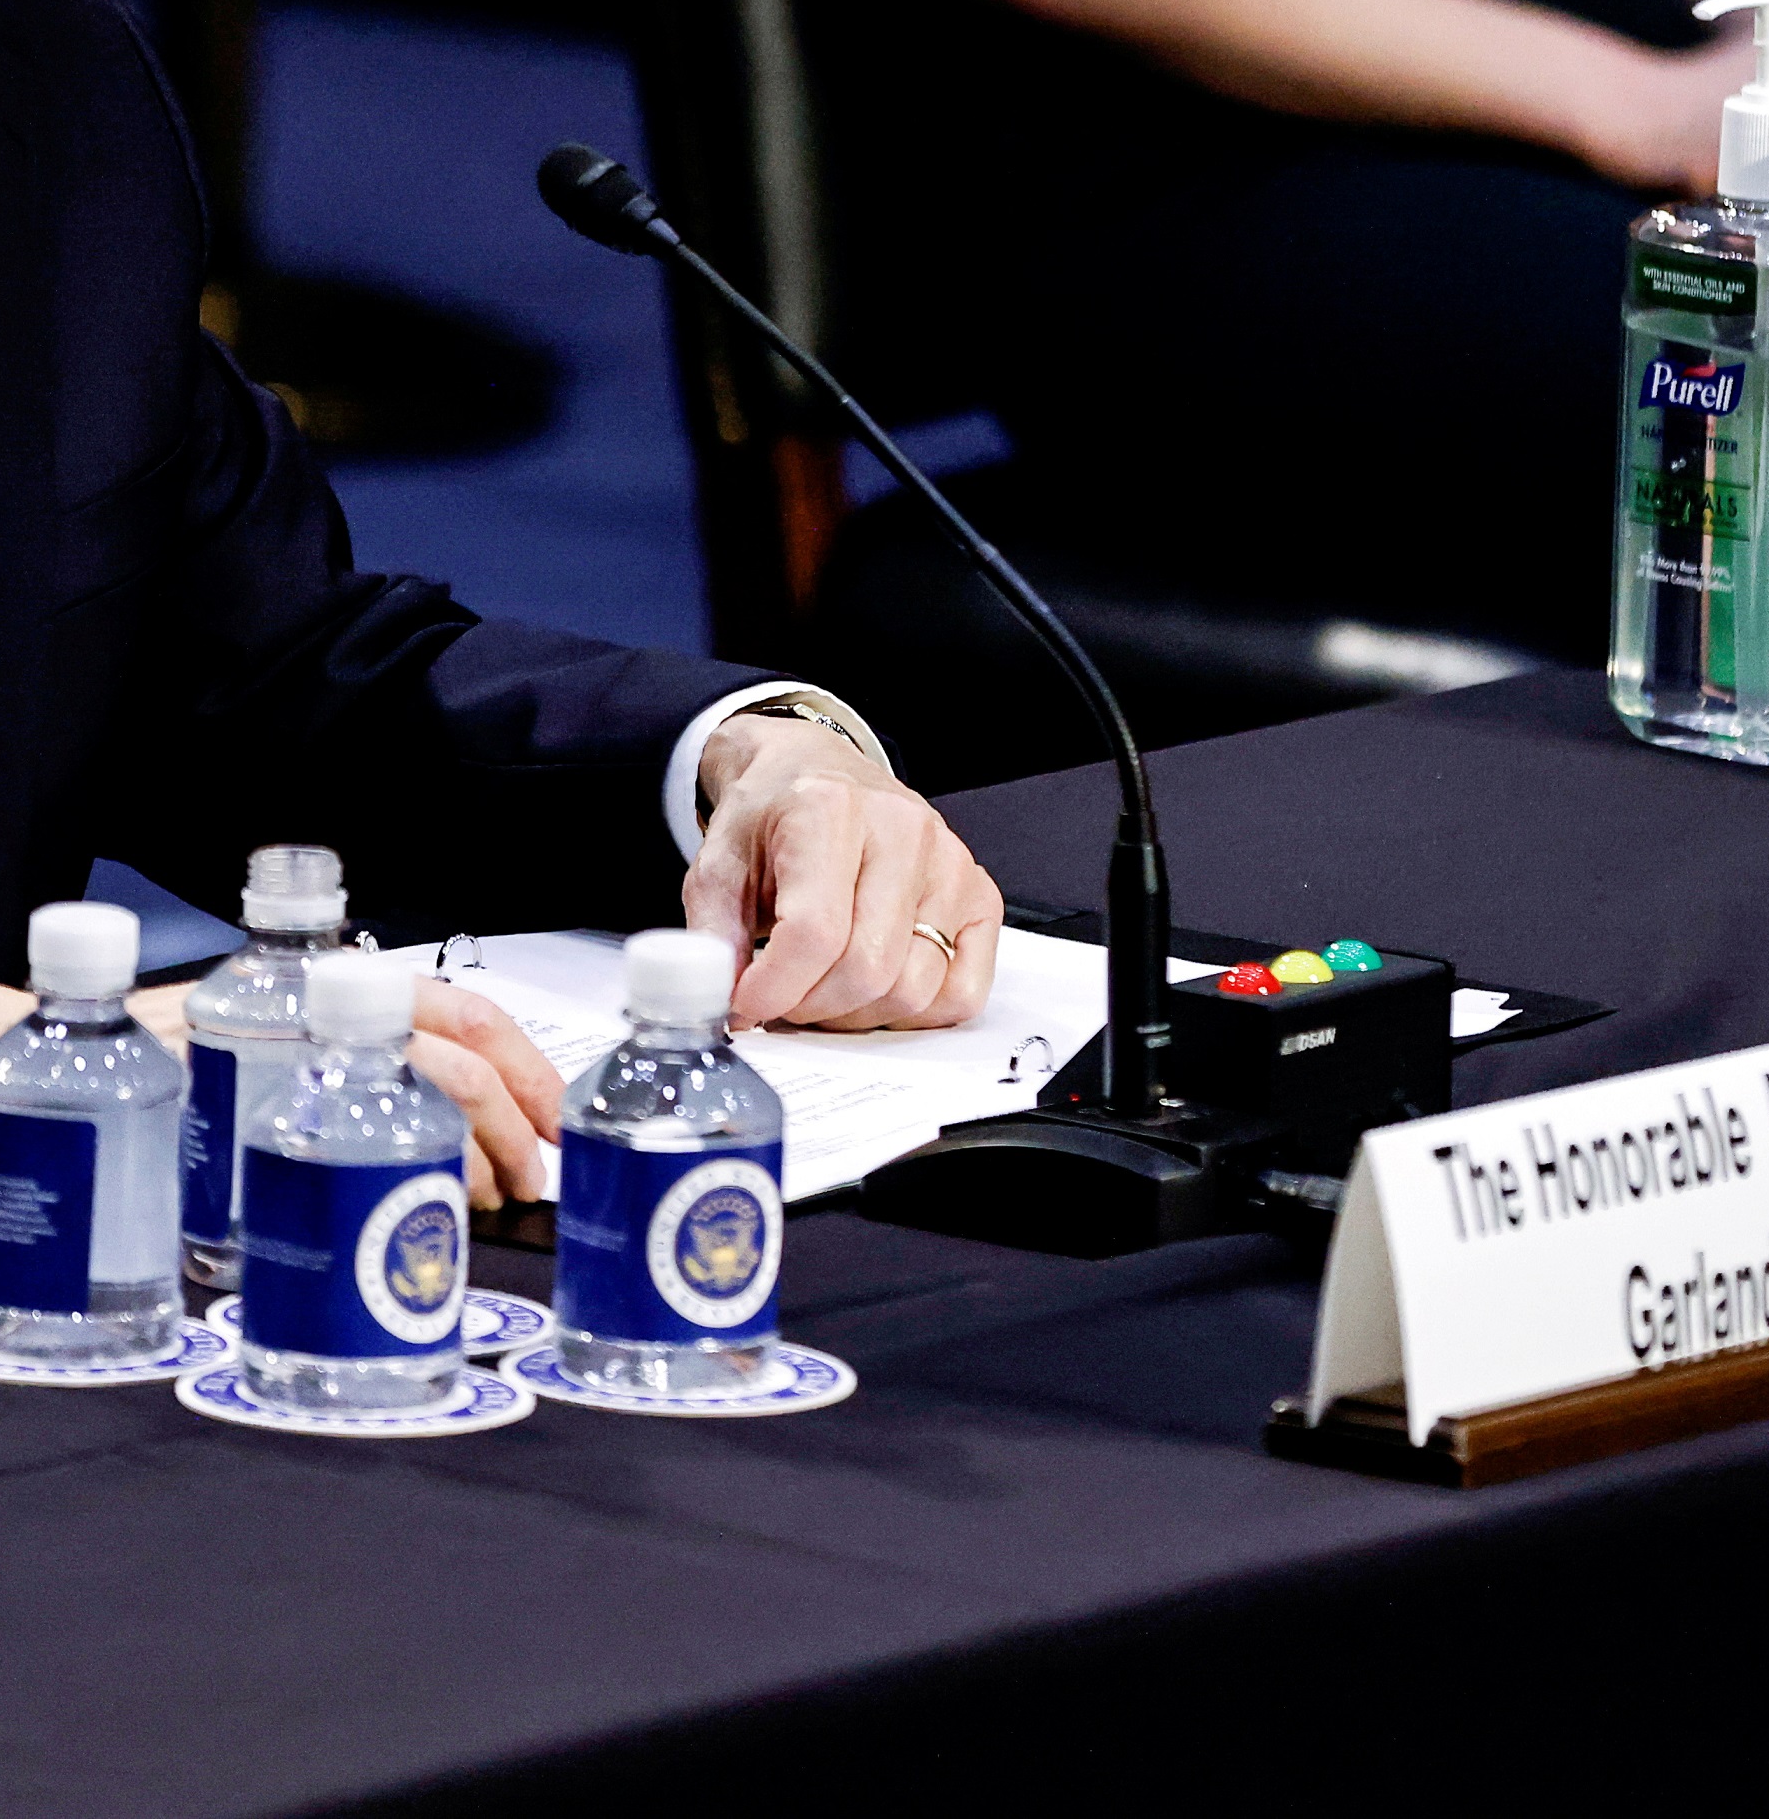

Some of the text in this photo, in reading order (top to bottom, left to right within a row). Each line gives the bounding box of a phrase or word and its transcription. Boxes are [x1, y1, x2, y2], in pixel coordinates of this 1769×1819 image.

[1643, 266, 1662, 279] WITH
[1663, 270, 1702, 287] ESSENTIAL
[1726, 281, 1745, 294] AND
[1651, 361, 1735, 412] Purell
[1429, 1142, 1525, 1242] The
[1523, 1086, 1753, 1223] Honorable
